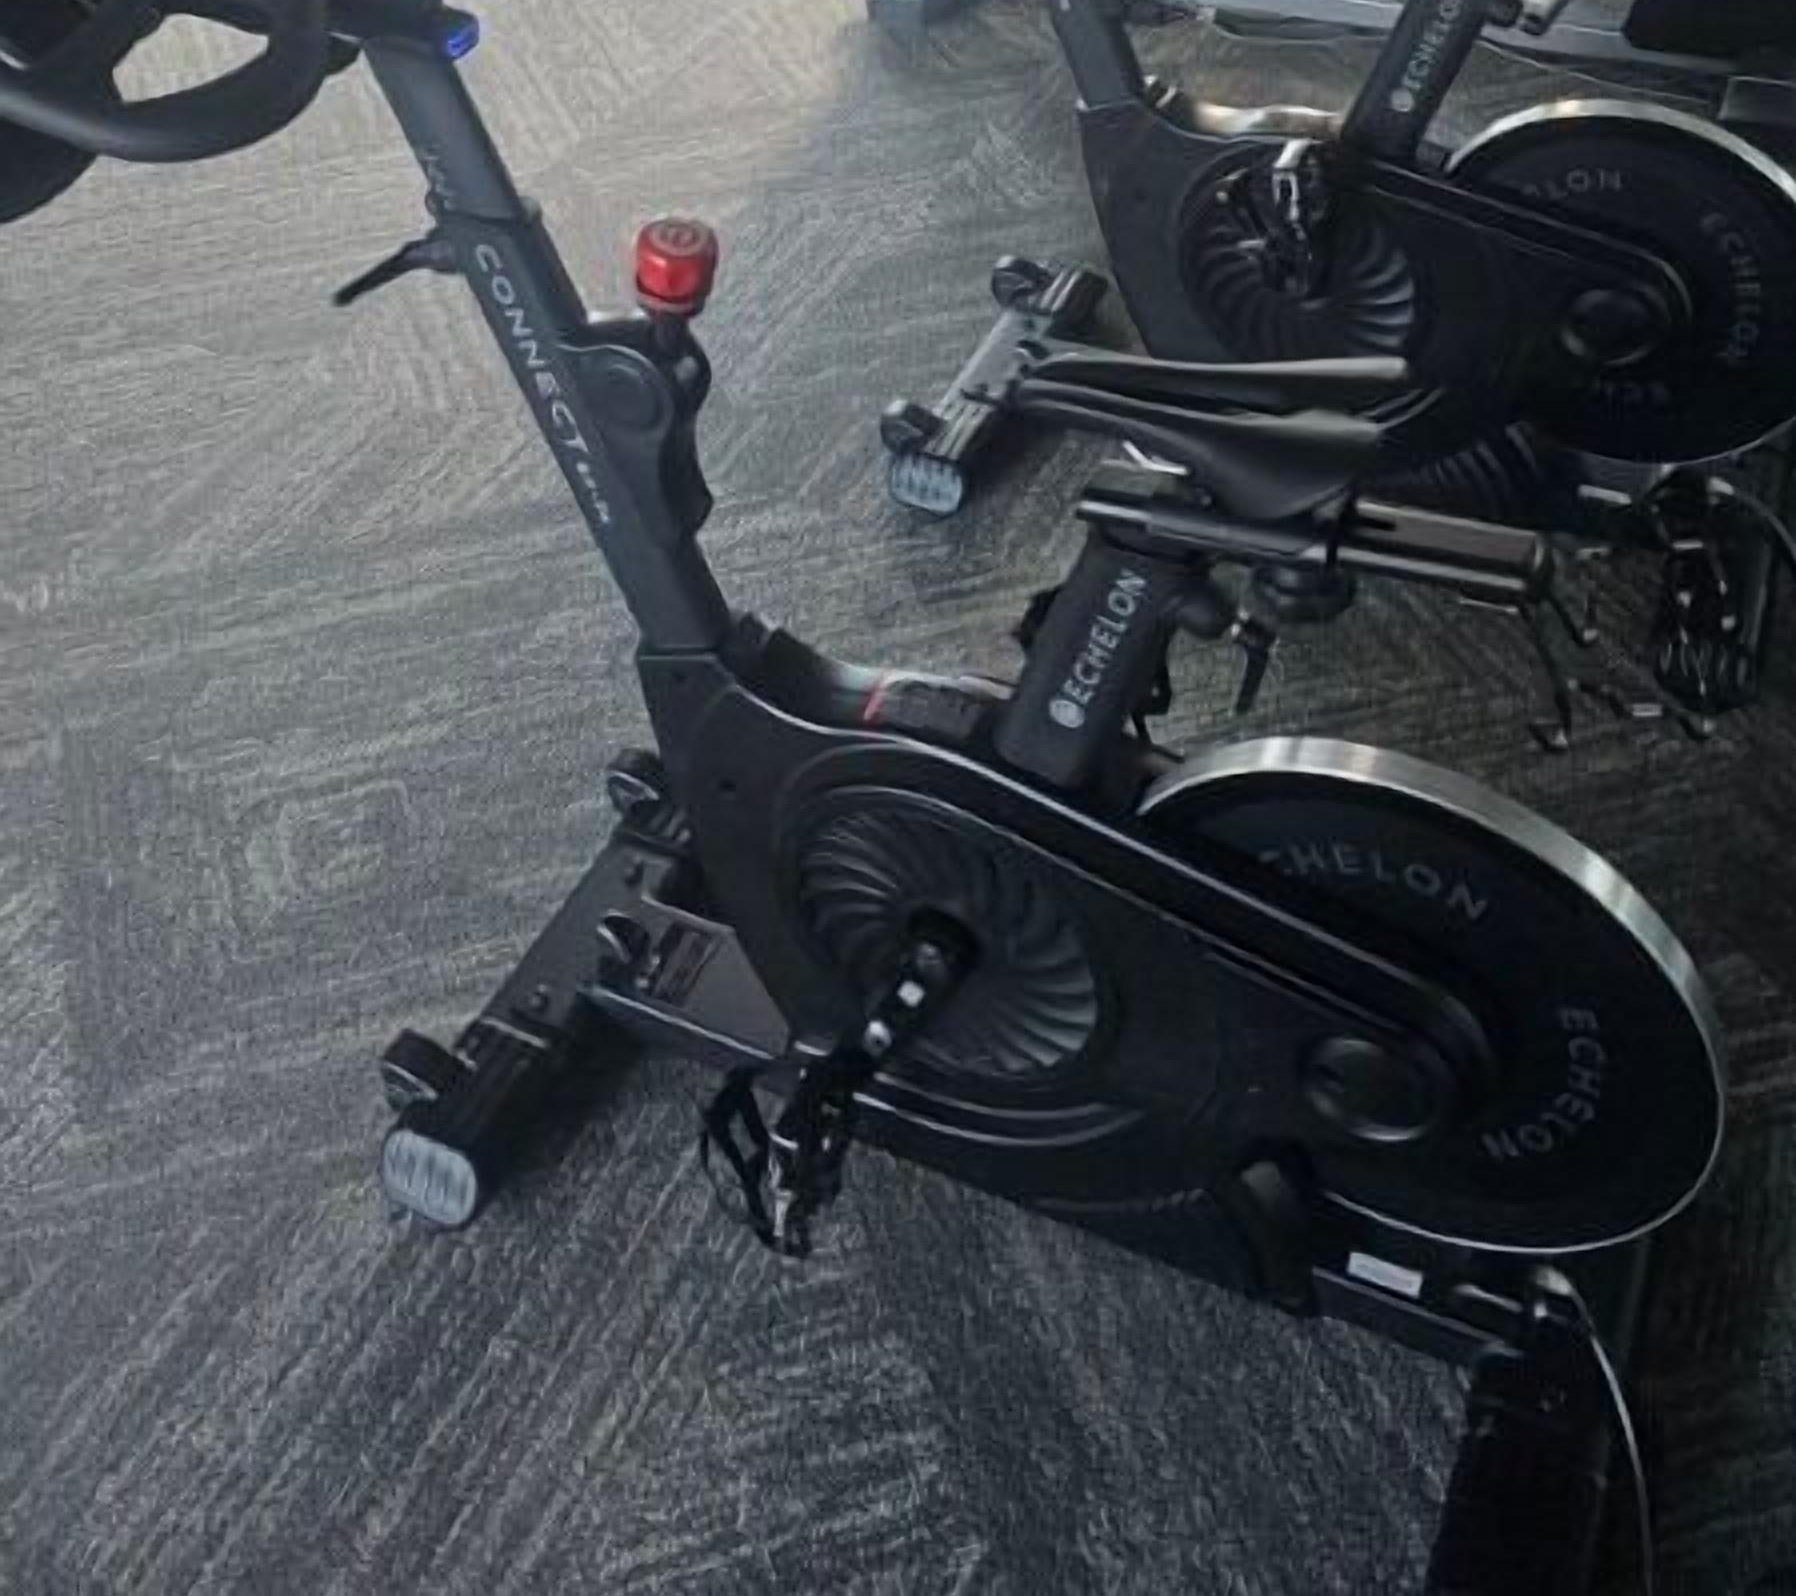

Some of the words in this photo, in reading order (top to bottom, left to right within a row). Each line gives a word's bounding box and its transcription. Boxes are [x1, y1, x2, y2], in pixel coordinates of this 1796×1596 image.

[473, 243, 591, 455] CONNECT
[1063, 567, 1148, 705] ECHELON
[1480, 1007, 1608, 1162] ECHELON
